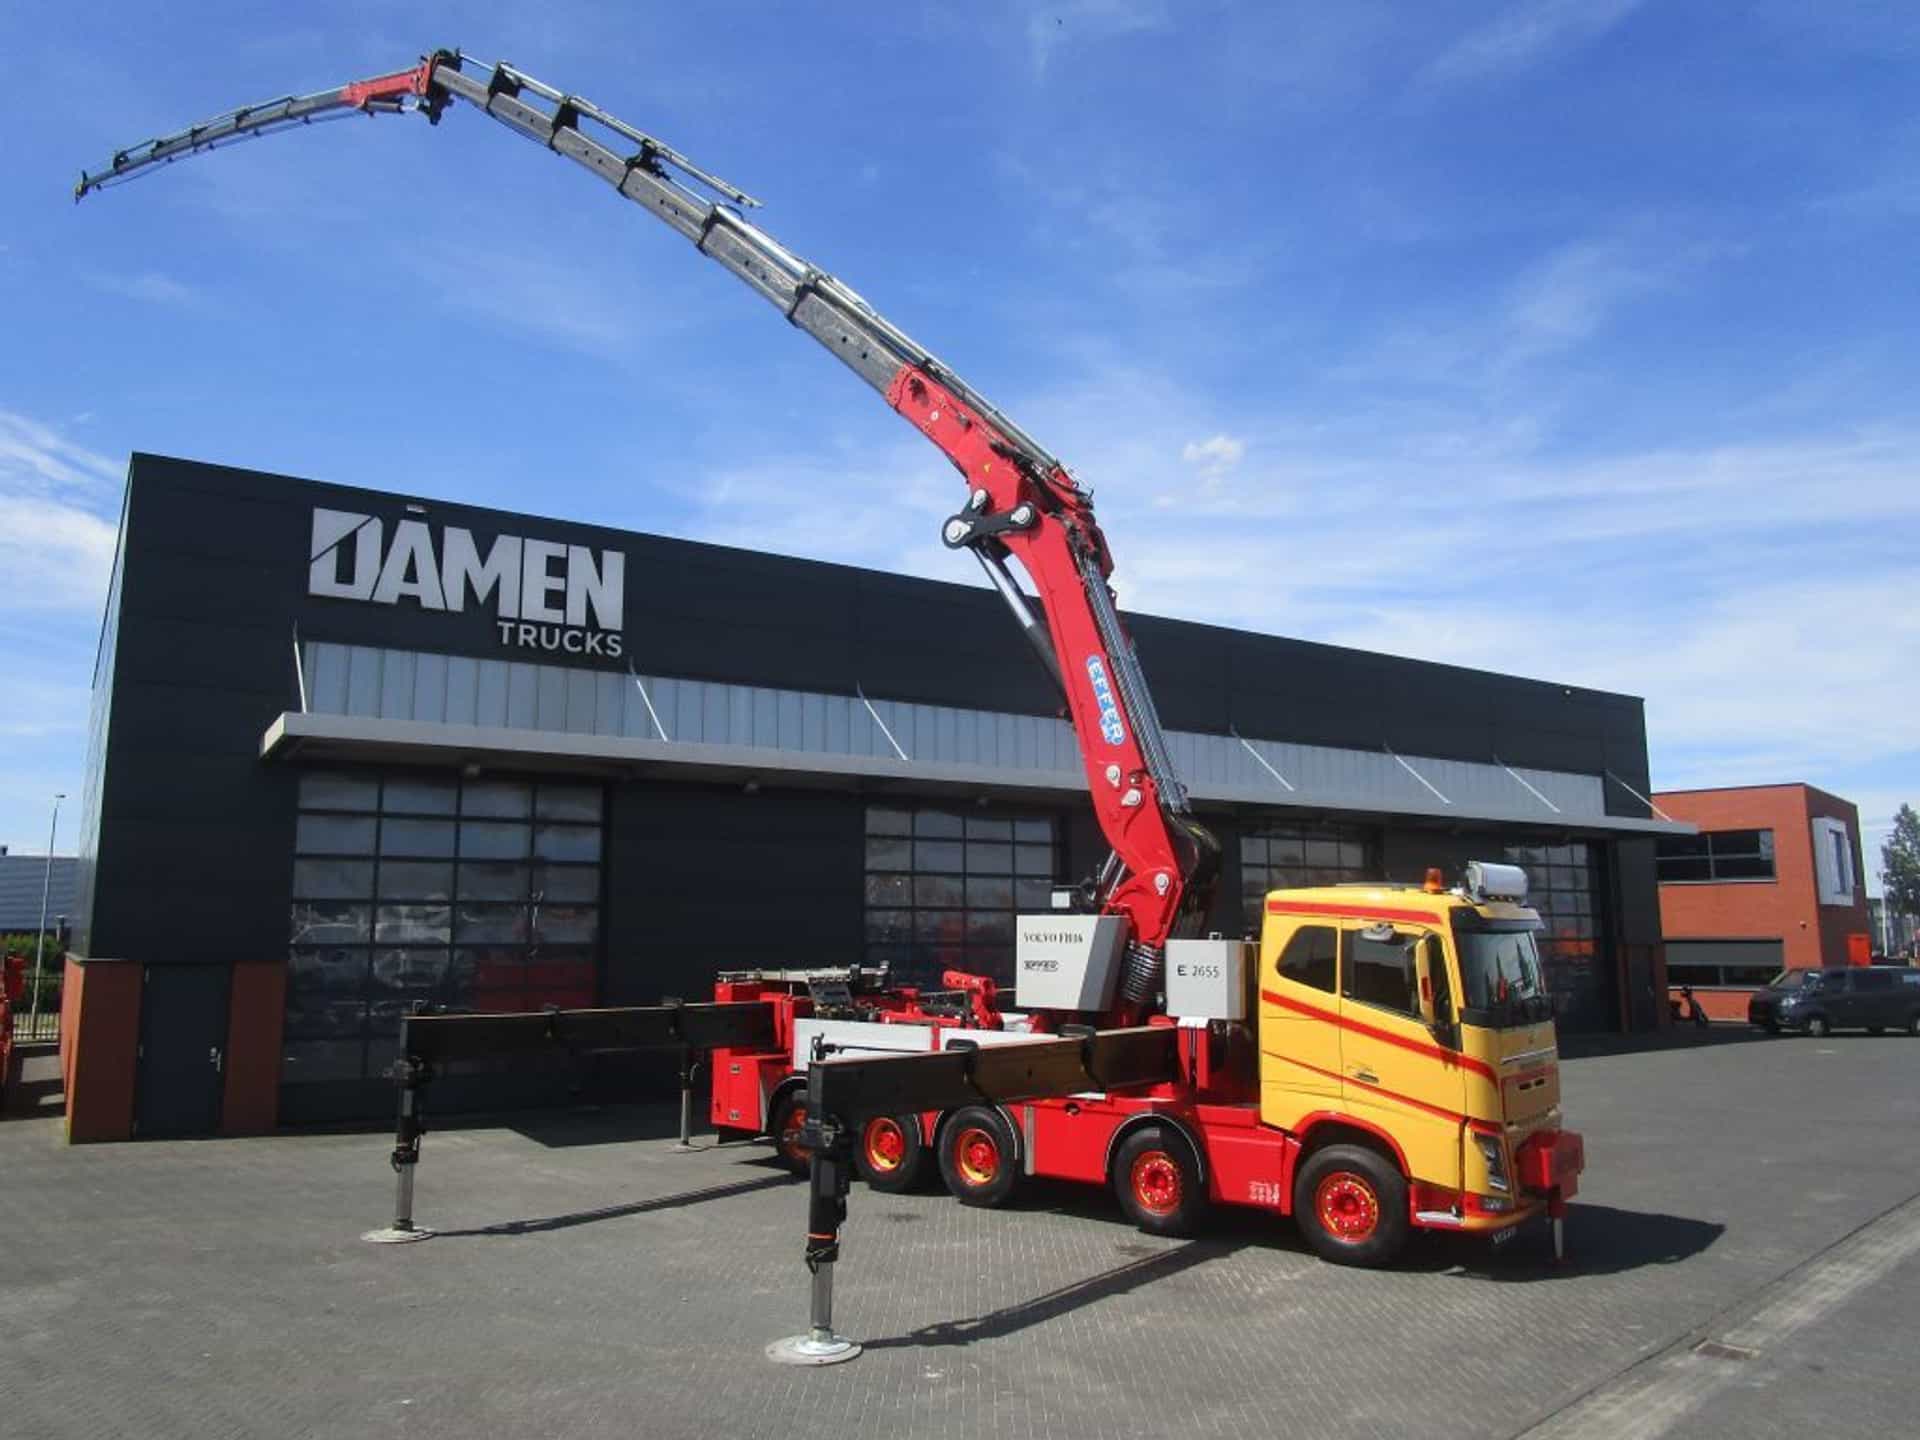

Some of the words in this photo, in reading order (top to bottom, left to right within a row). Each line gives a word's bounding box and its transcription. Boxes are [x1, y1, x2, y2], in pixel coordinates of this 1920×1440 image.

[309, 507, 625, 631] DAMEN
[497, 621, 623, 657] TRUCKS
[1023, 932, 1057, 943] VOLVO
